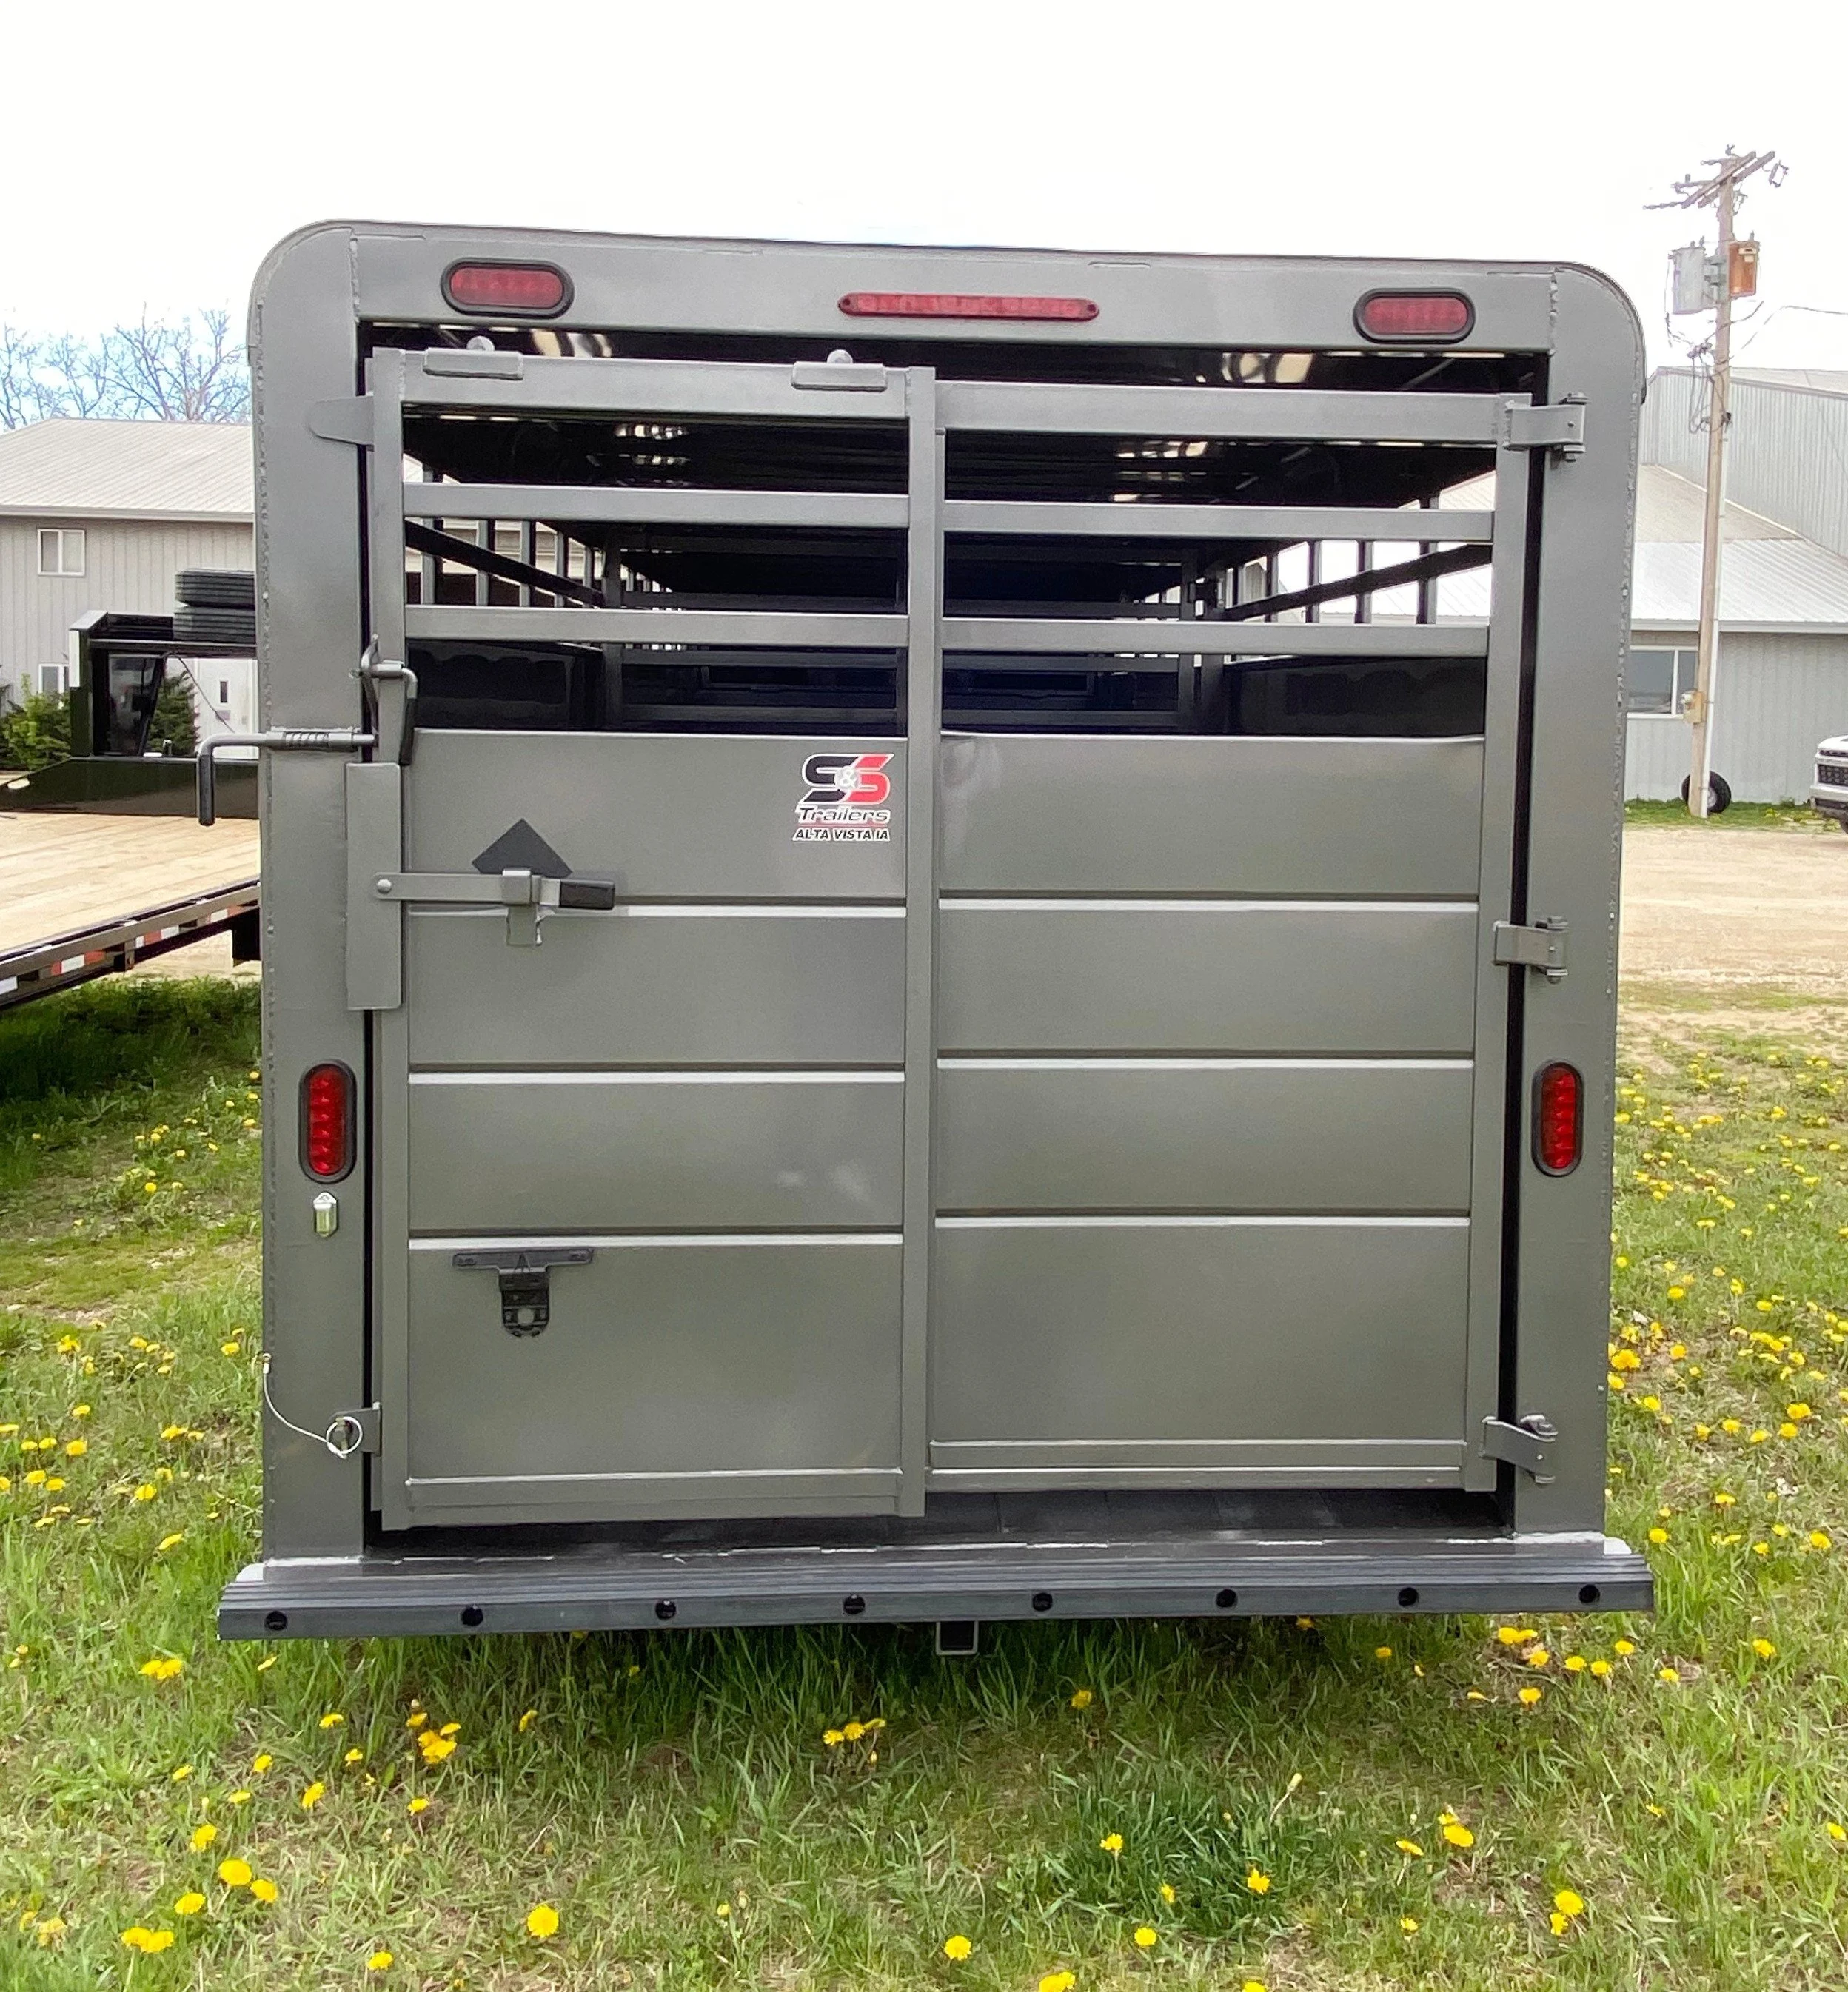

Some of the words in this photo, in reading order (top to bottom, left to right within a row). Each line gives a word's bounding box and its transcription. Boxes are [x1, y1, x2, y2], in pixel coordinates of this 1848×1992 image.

[797, 806, 889, 822] Trailers
[795, 829, 829, 839] ALTA
[834, 829, 872, 839] VISTA
[875, 829, 889, 839] IA
